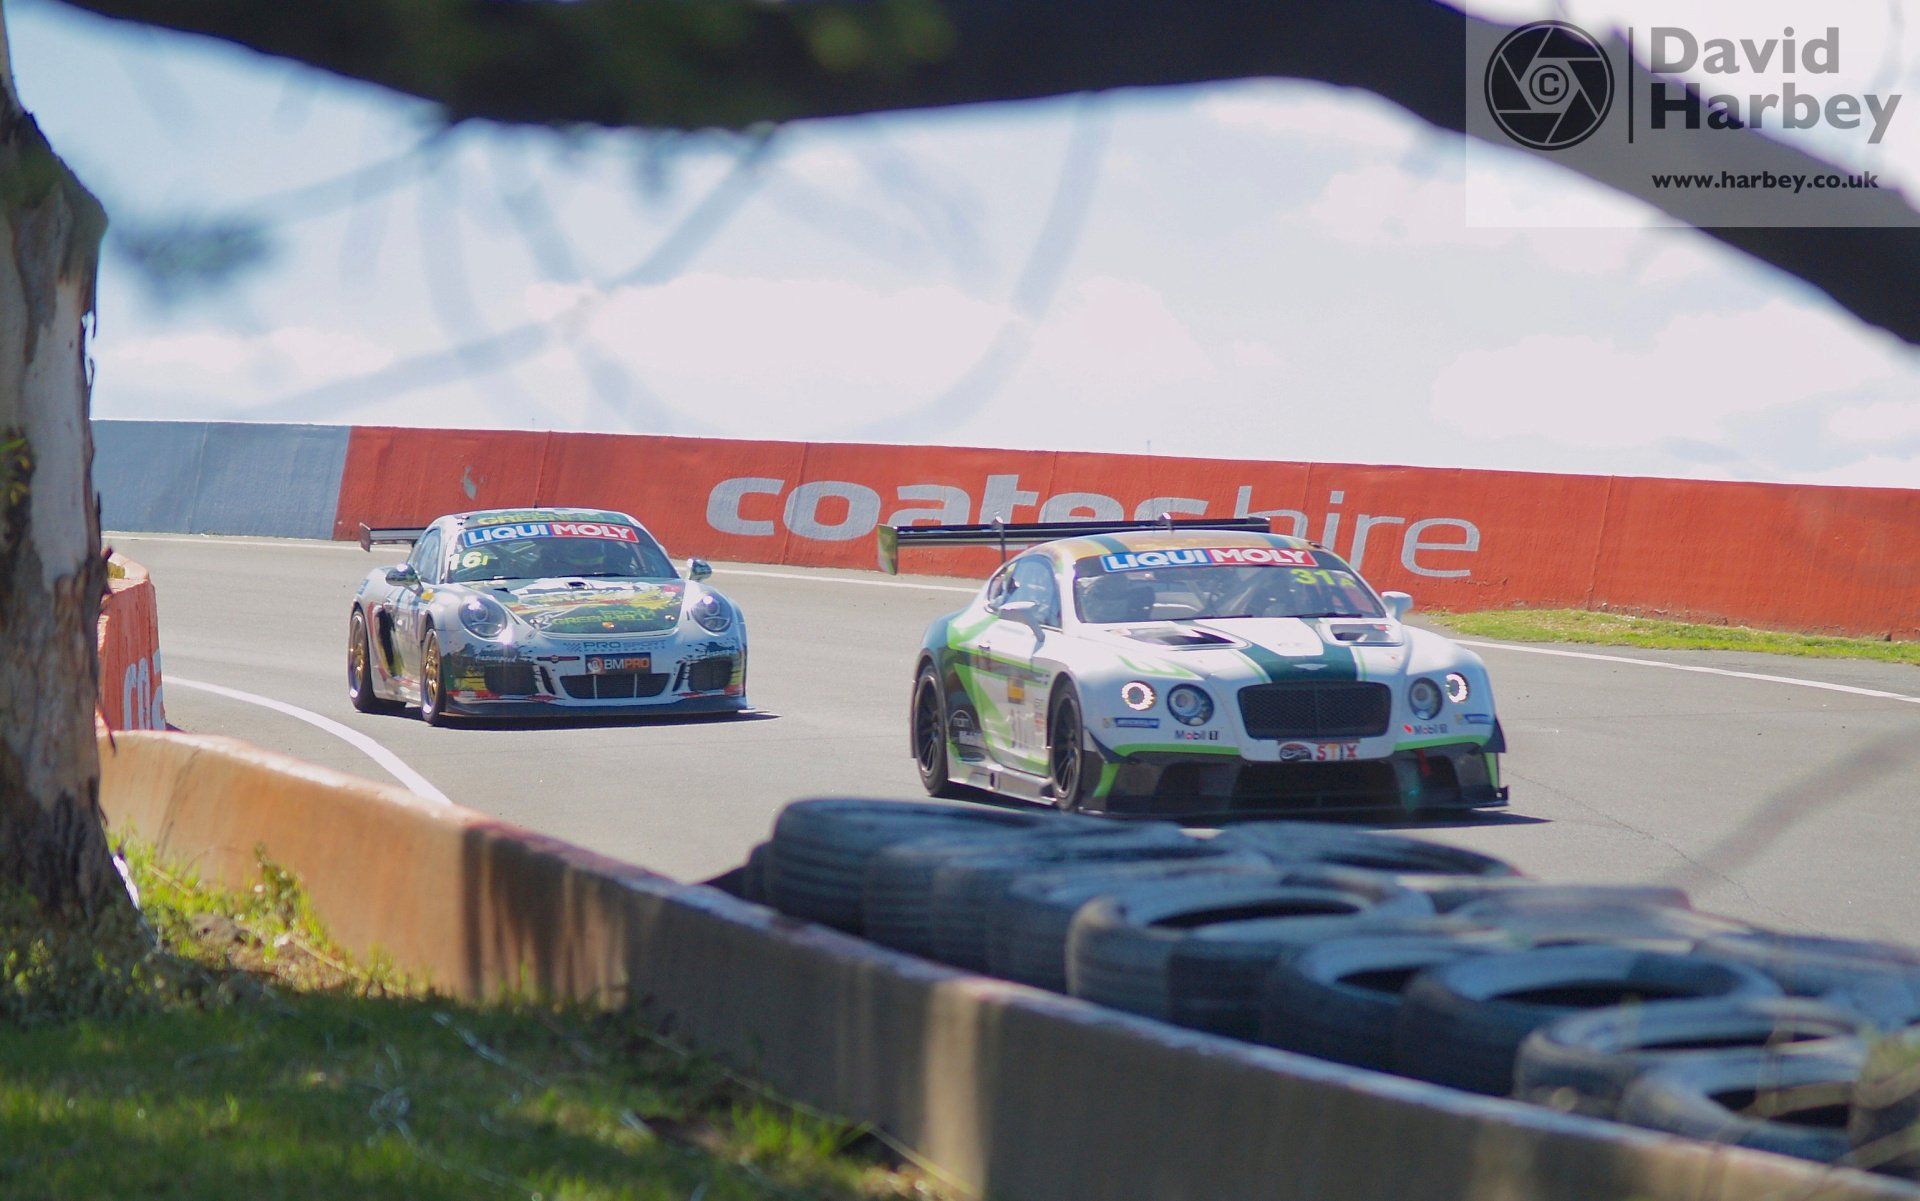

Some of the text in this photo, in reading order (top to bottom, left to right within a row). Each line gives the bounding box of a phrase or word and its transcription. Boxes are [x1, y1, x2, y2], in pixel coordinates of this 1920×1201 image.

[469, 523, 630, 544] LIQUI MOLY
[1109, 548, 1307, 570] LIQUI MOLY
[583, 641, 621, 649] PRO
[603, 657, 650, 671] BMPRO
[1175, 729, 1206, 740] Mobil
